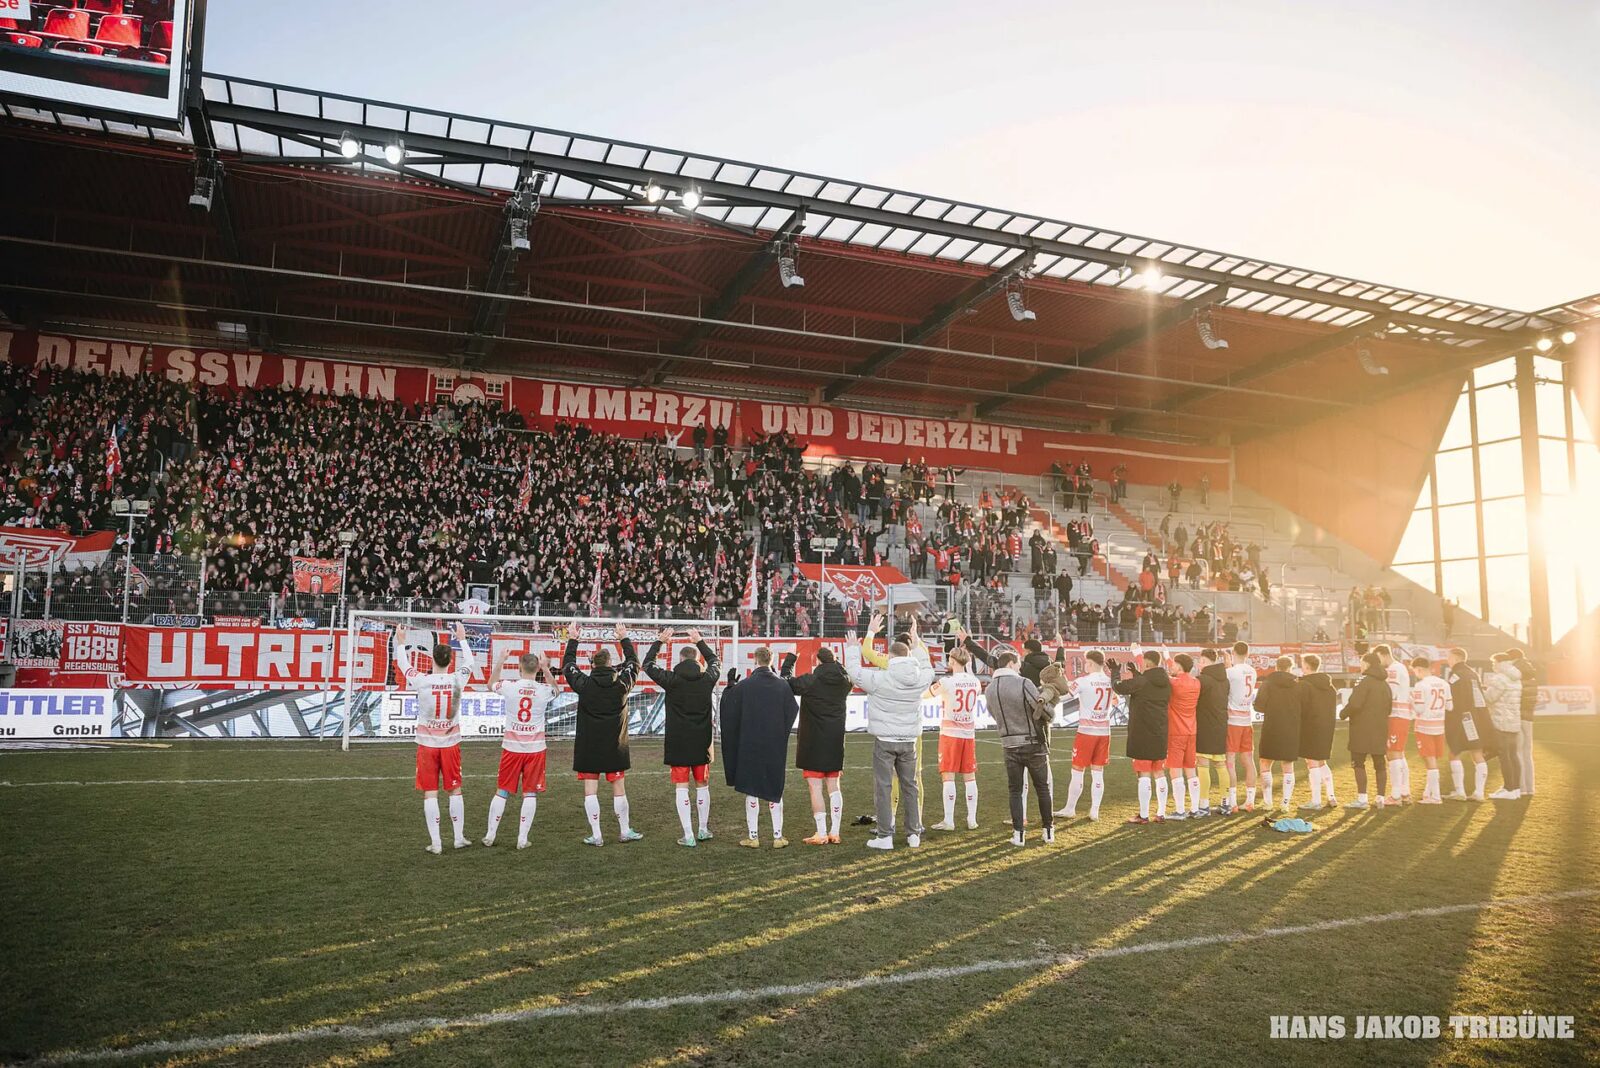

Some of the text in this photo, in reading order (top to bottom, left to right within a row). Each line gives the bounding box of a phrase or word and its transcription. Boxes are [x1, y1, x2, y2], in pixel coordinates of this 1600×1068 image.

[35, 335, 397, 400] DEN SSV JAHN
[540, 383, 1022, 455] IMMERZU UND JEDERZEIT
[67, 624, 120, 636] SSV JAHN
[66, 636, 119, 661] 1889
[147, 632, 374, 679] ULTRAS
[64, 662, 119, 672] REGENSBURG
[1245, 675, 1252, 698] 5
[431, 690, 452, 720] 11
[517, 696, 533, 723] 8
[953, 689, 977, 713] 30
[1093, 687, 1113, 711] 27
[1430, 688, 1445, 711] 25
[53, 725, 102, 736] GmbH
